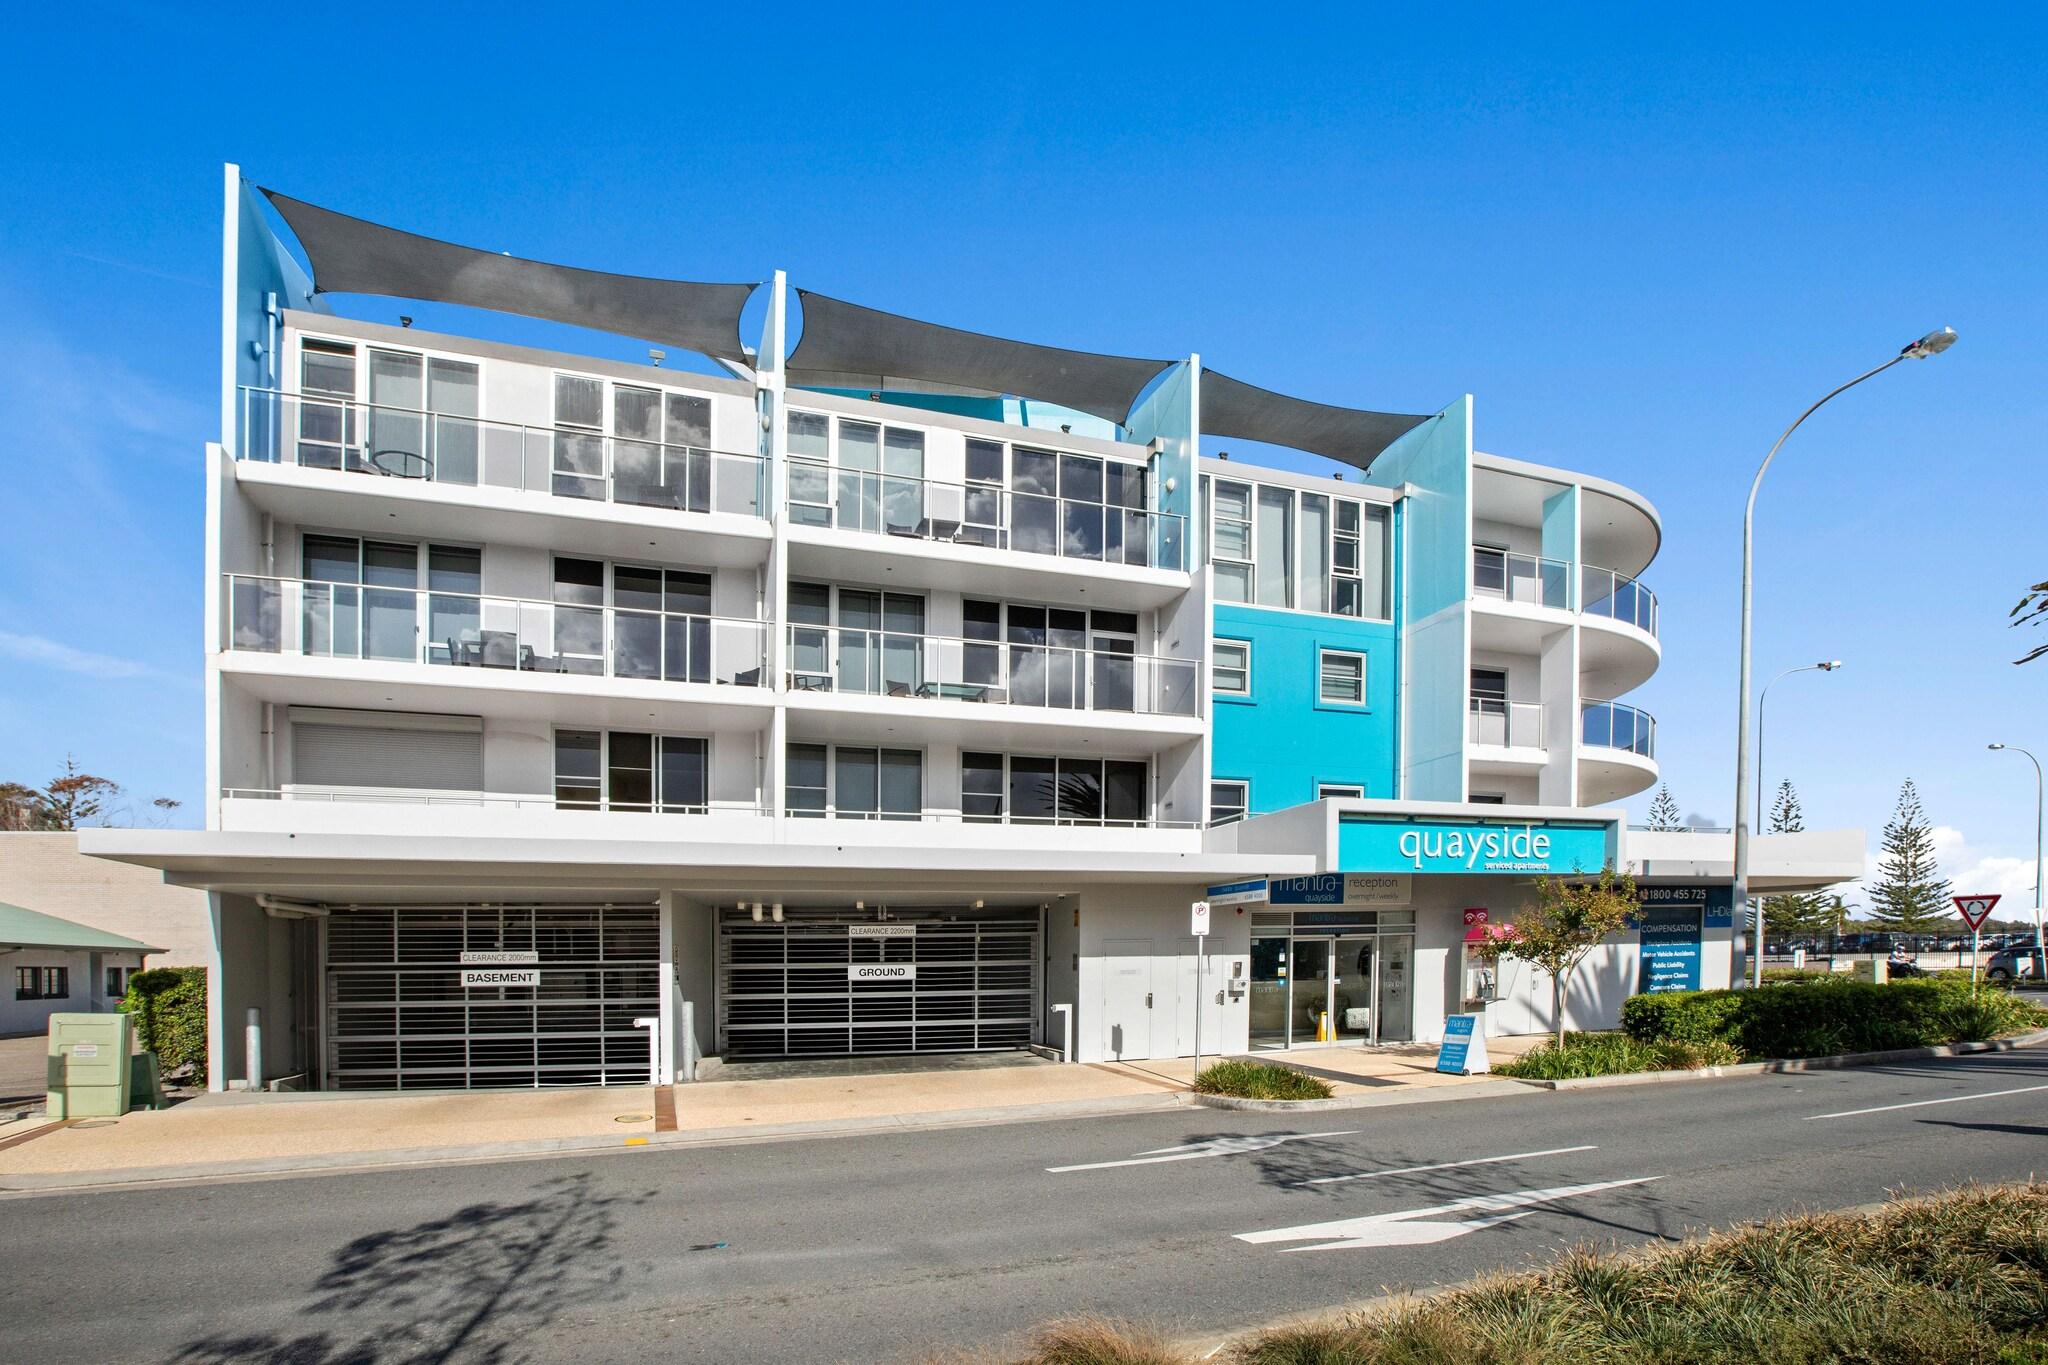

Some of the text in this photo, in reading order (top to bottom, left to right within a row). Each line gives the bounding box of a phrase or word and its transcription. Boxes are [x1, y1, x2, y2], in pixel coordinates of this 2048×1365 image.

[1400, 825, 1550, 869] quayside
[1484, 862, 1549, 871] serviced apartments
[1279, 874, 1342, 892] mantra
[1349, 876, 1398, 891] reception
[1304, 893, 1336, 903] quayside
[1649, 889, 1707, 899] 1800 455 725
[1641, 924, 1698, 933] COMPENSATION
[463, 953, 537, 962] CLEARANCE 2000mm
[858, 968, 906, 977] GROUND
[467, 973, 534, 983] BASEMENT
